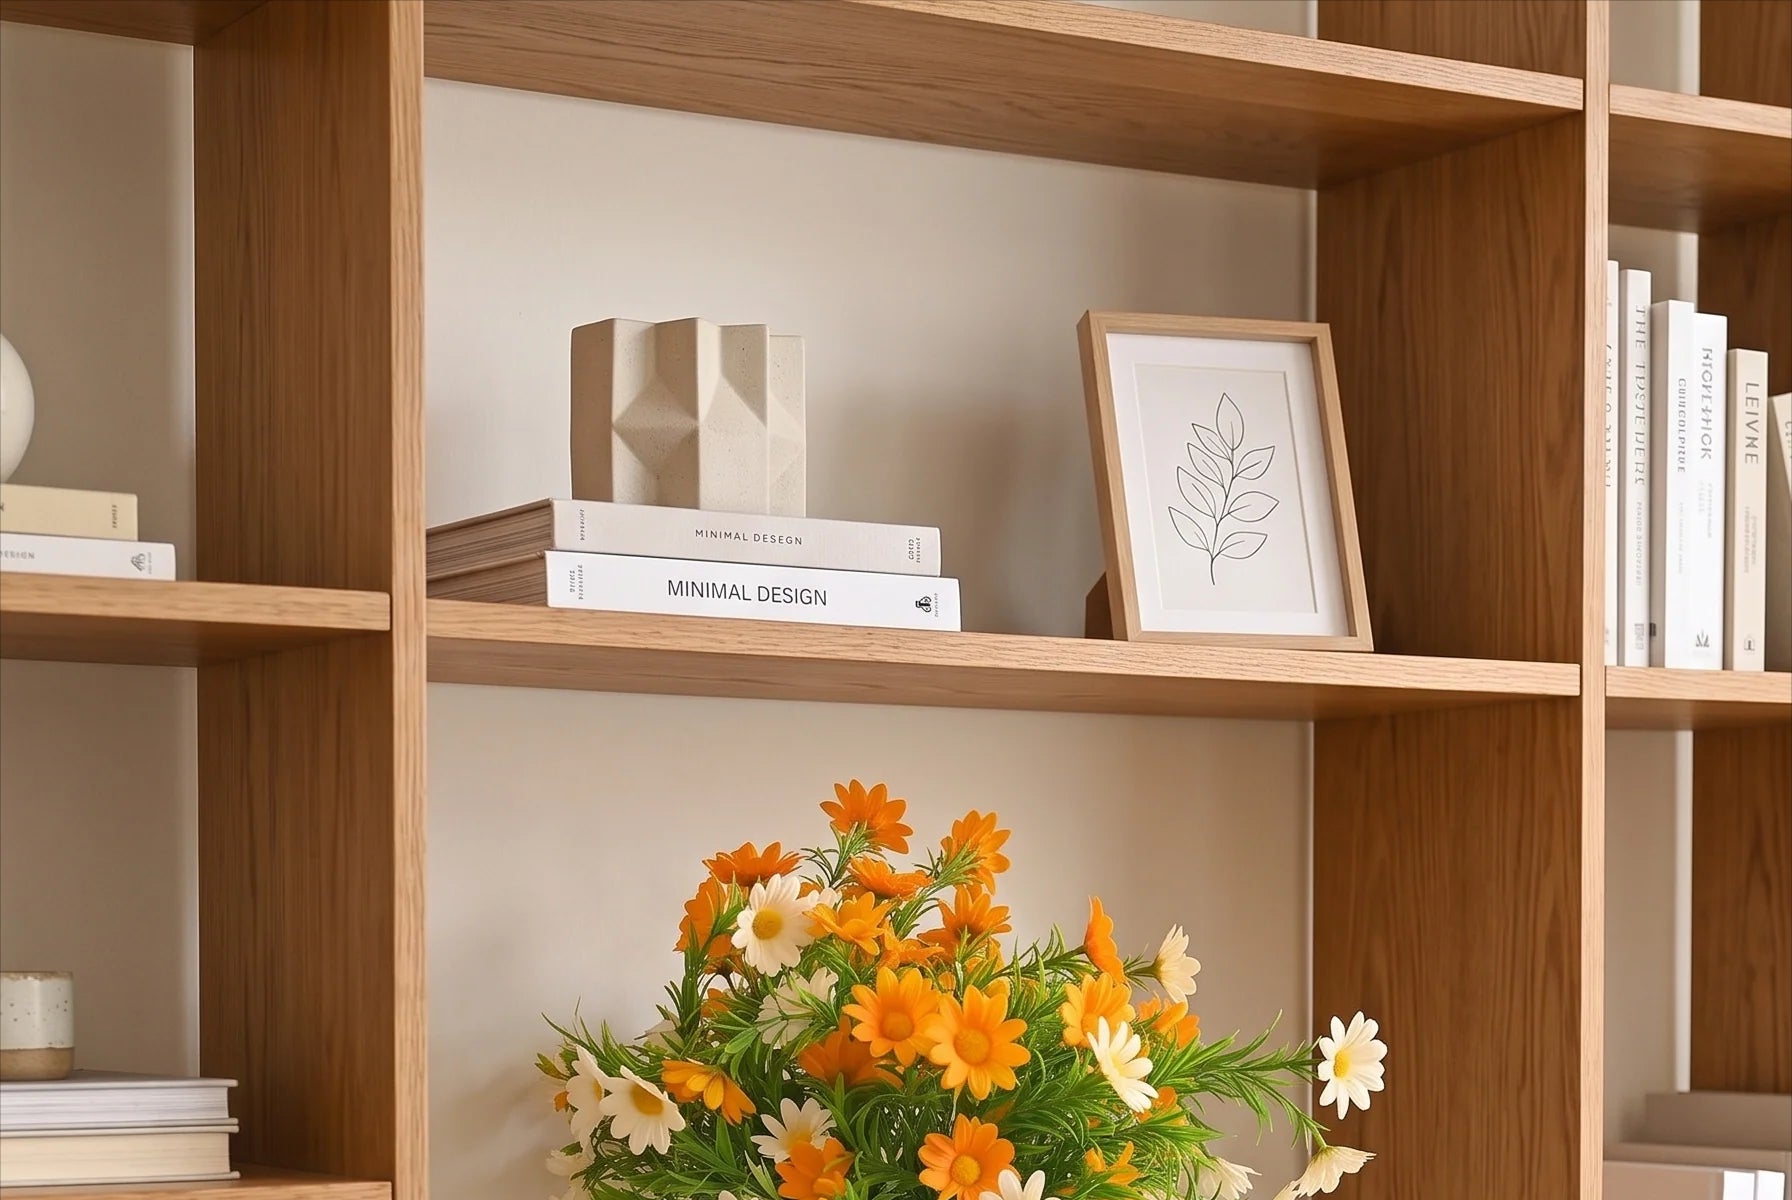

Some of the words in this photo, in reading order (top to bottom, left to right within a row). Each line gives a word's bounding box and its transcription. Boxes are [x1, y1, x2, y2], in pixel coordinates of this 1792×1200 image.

[695, 529, 749, 541] MINIMAL
[753, 533, 803, 545] DESEGN
[668, 579, 752, 601] MINIMAL
[757, 585, 827, 606] DESIGN
